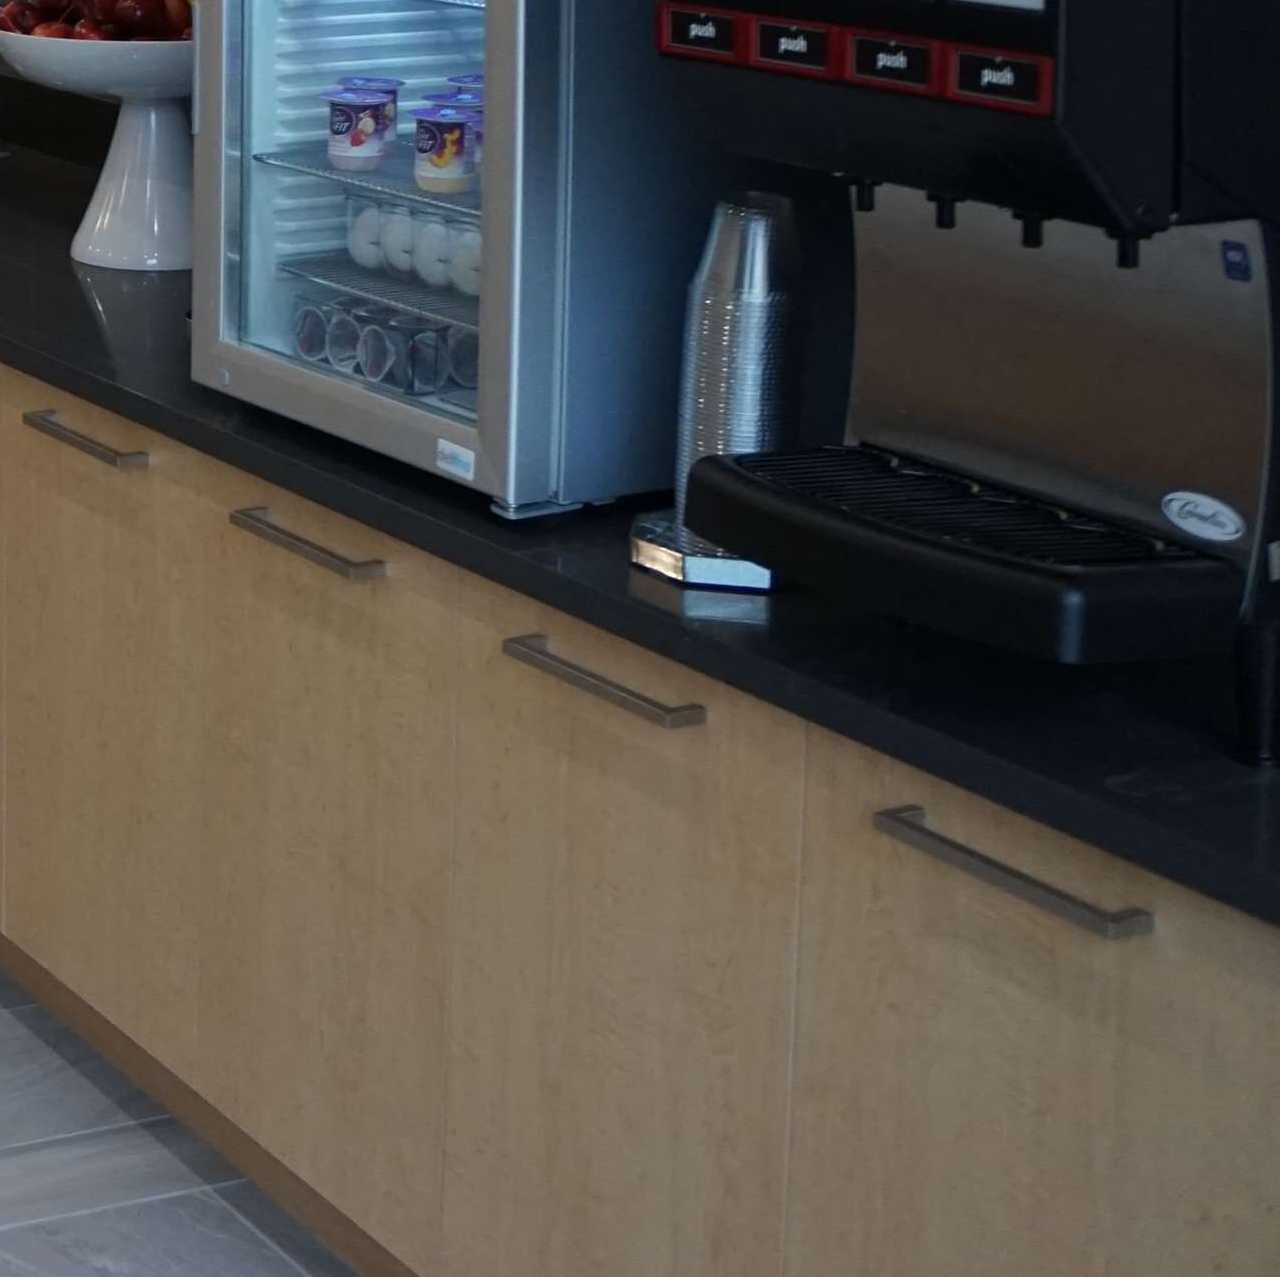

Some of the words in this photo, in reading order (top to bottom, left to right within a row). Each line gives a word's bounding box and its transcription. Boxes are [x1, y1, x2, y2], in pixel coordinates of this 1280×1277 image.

[690, 21, 716, 40] push
[778, 35, 808, 54] push
[876, 50, 908, 69] push
[981, 66, 1014, 87] push
[334, 122, 351, 132] FIT
